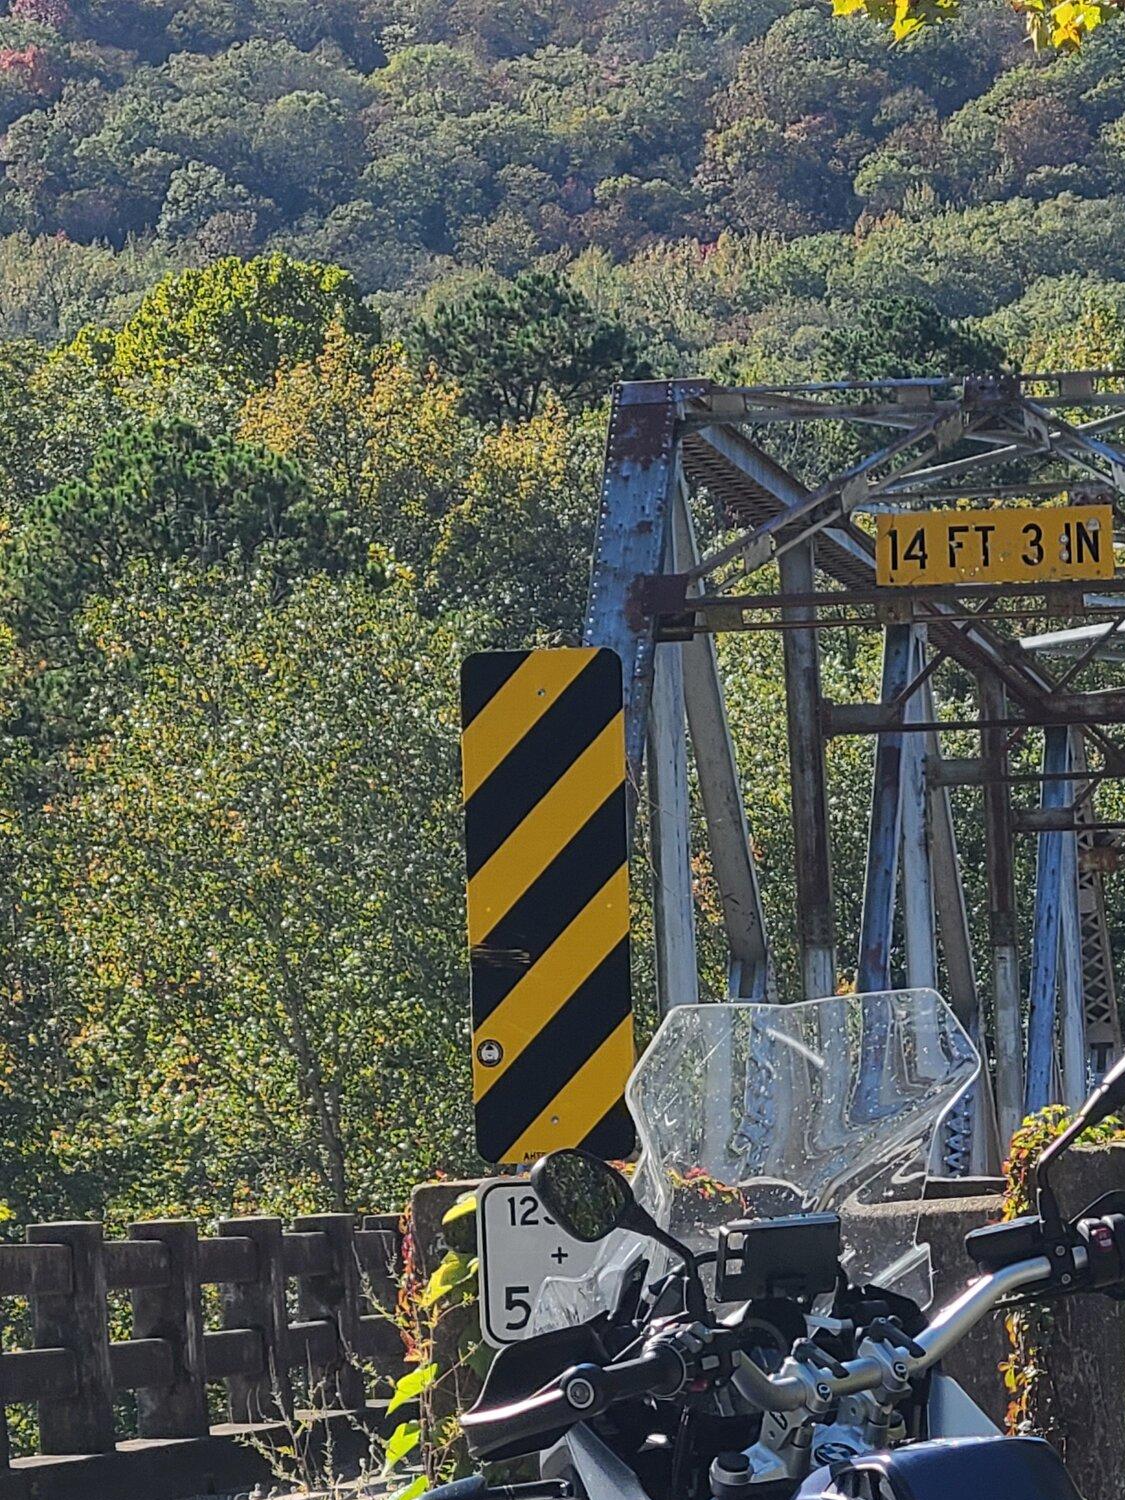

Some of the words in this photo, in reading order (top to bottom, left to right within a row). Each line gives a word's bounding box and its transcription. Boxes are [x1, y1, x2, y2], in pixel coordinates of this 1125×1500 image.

[887, 527, 928, 571] 14
[948, 525, 996, 568] FT
[1021, 522, 1044, 567] 3
[1063, 521, 1101, 565] IN
[507, 1195, 556, 1226] 12
